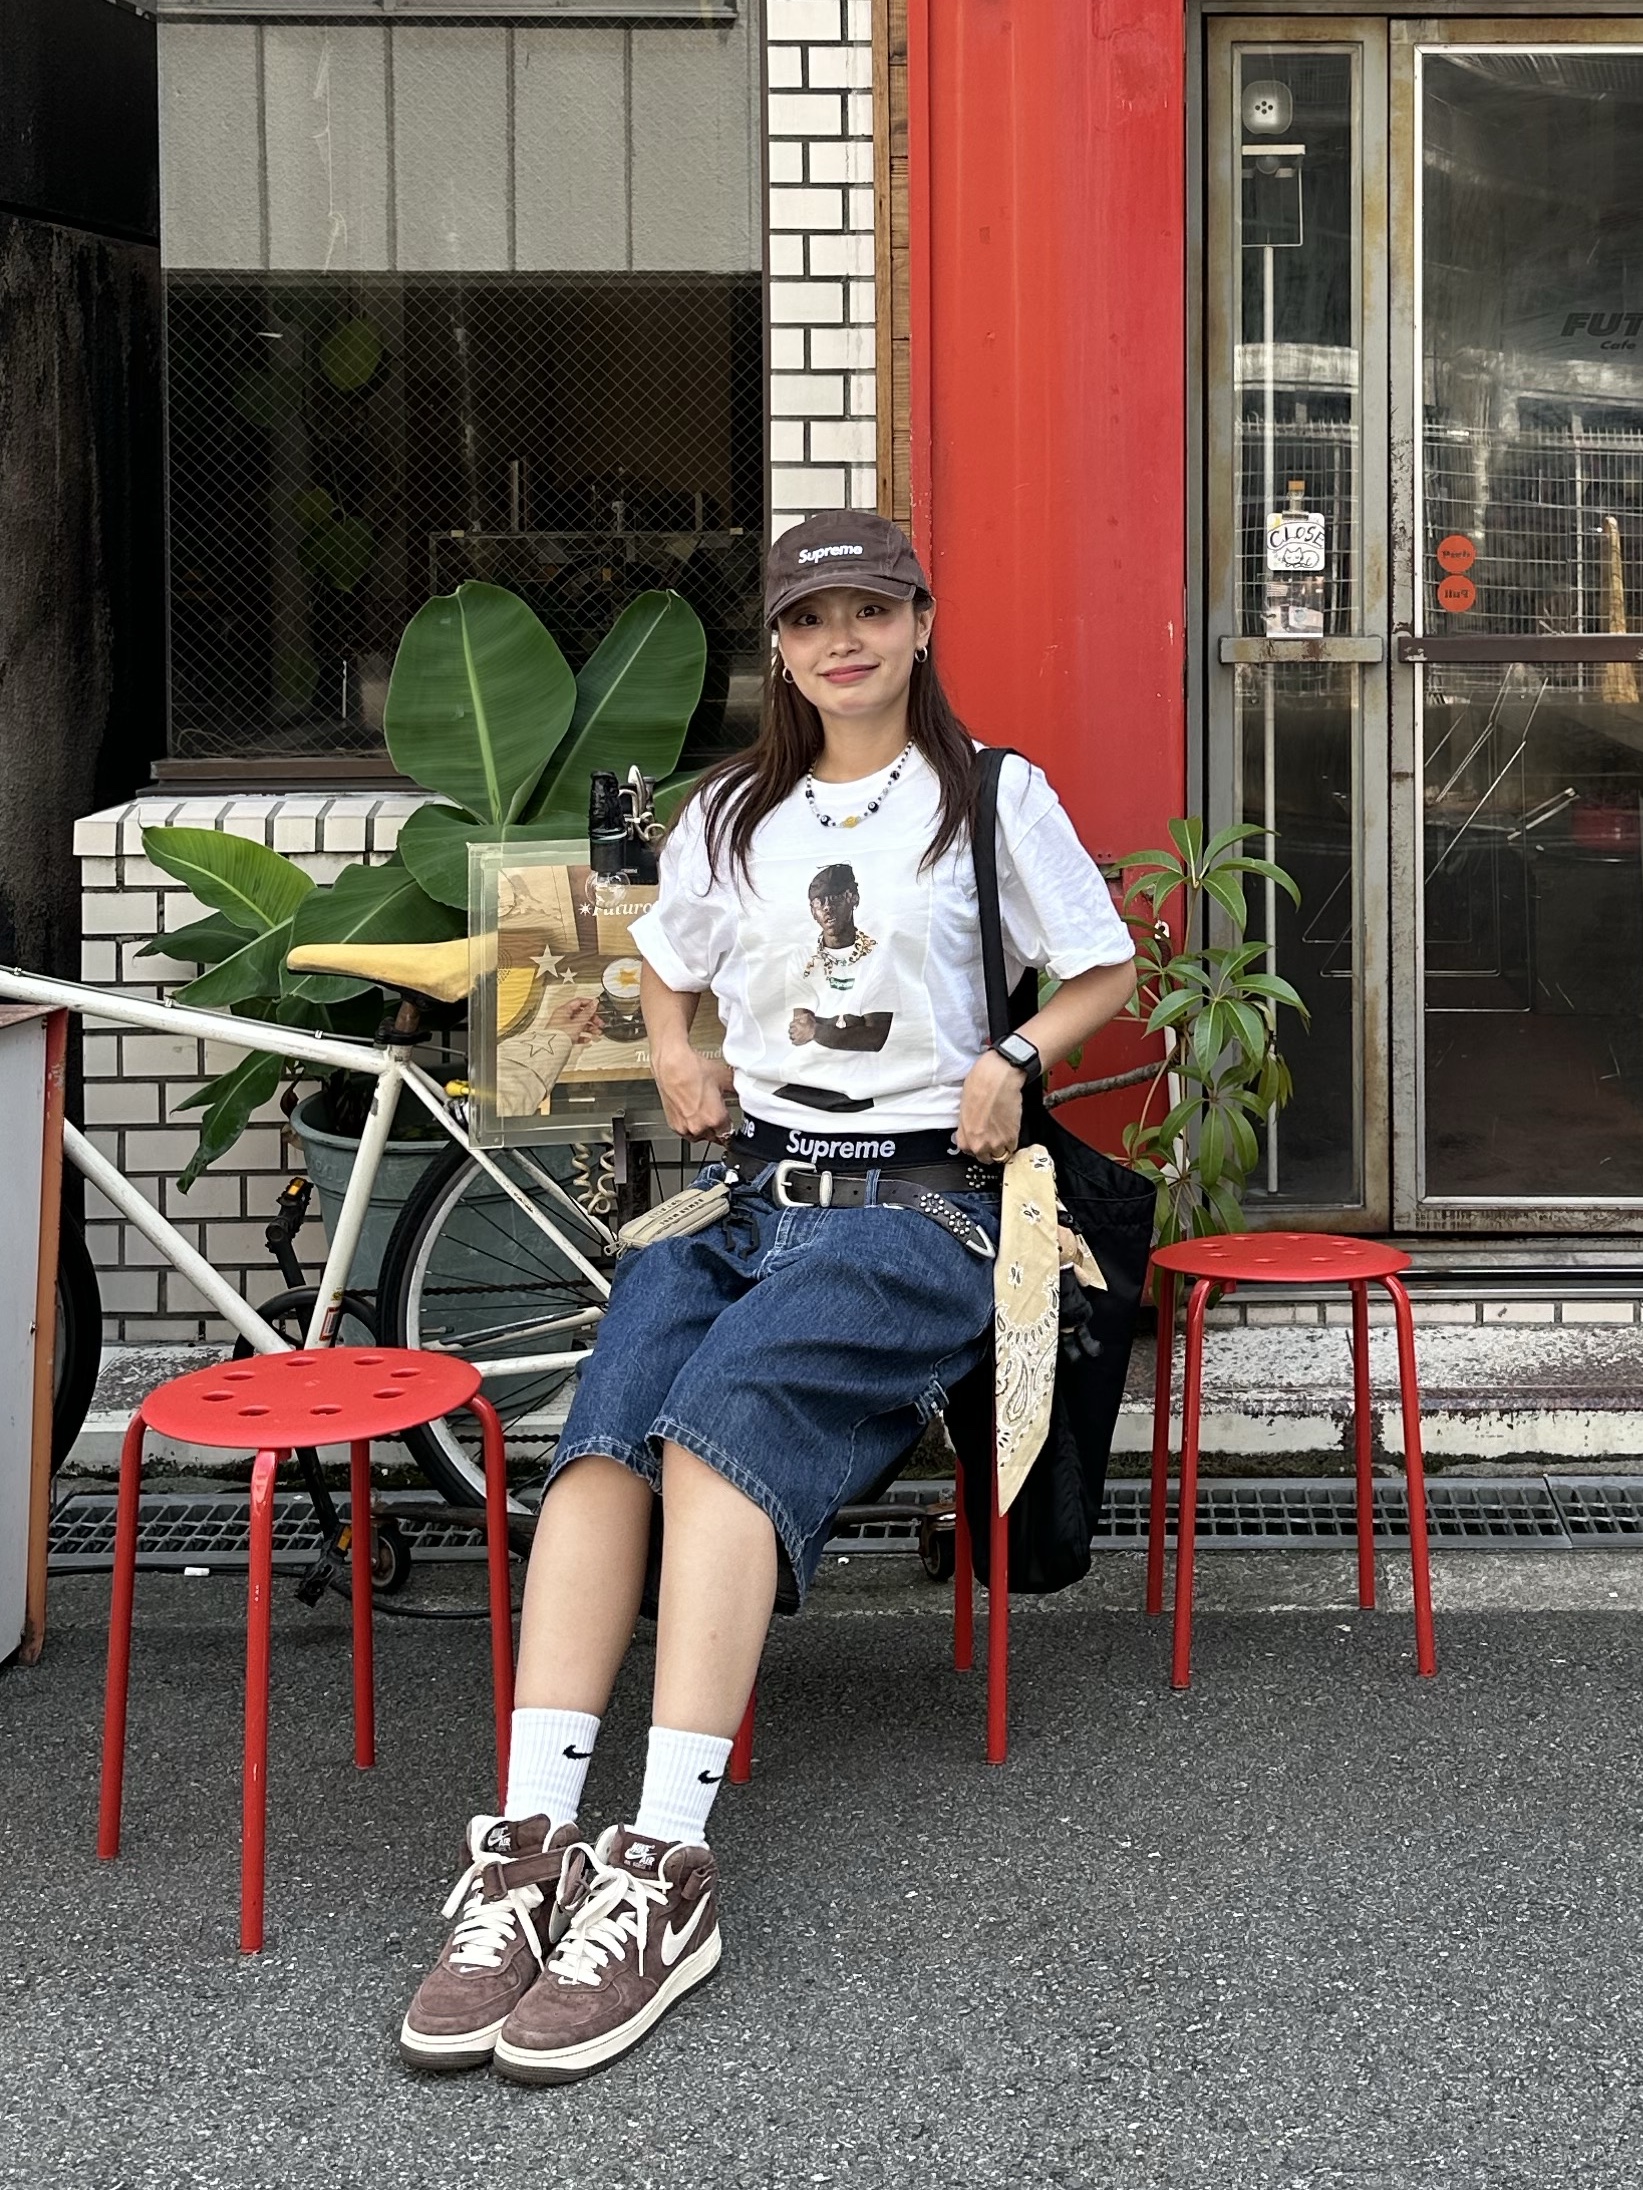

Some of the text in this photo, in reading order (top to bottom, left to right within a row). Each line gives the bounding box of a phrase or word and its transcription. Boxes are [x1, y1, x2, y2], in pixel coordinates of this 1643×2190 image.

[1600, 339, 1637, 350] Cafe
[1269, 526, 1325, 549] CLOSE
[798, 544, 864, 564] Supreme
[785, 1128, 897, 1165] Supreme
